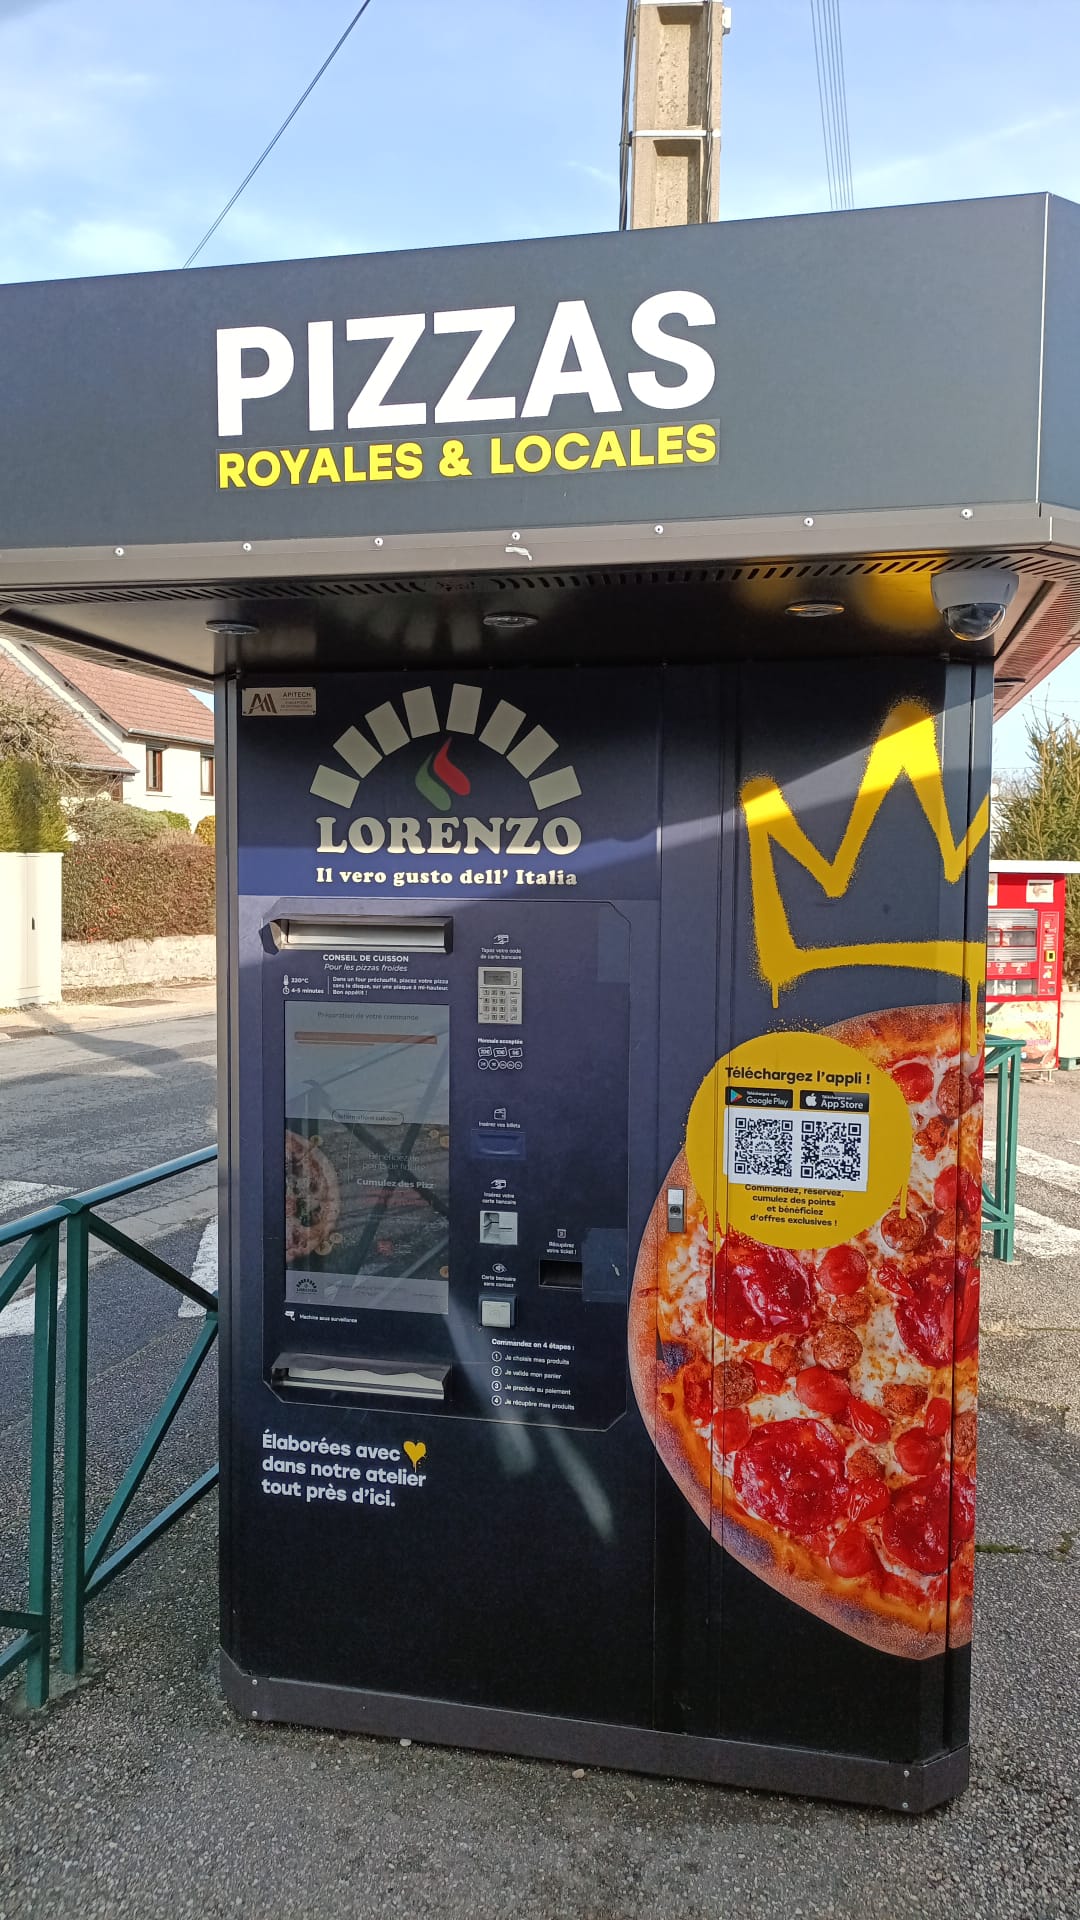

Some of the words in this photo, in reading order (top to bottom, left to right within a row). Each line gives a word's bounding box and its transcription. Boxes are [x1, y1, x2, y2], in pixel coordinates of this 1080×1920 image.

[216, 290, 716, 437] PIZZAS
[217, 442, 424, 489] ROYALES
[439, 440, 473, 477] &
[489, 423, 717, 475] LOCALES
[315, 817, 582, 855] LORENZO
[316, 867, 333, 883] Il
[339, 870, 387, 884] vero
[393, 869, 453, 887] gusto
[460, 869, 508, 884] dell'
[516, 870, 578, 886] Italia
[323, 954, 357, 962] CONSEIL
[324, 963, 341, 971] Pour
[356, 964, 379, 972] pizzas
[725, 1067, 813, 1084] Téléchargez
[817, 1070, 862, 1086] l'appli
[866, 1073, 871, 1084] !
[746, 1096, 773, 1106] Google
[773, 1097, 788, 1107] Play
[820, 1099, 839, 1109] App
[840, 1100, 863, 1109] Store
[356, 1178, 397, 1187] Cumulez
[397, 1179, 414, 1188] des
[744, 1184, 802, 1195] Commandez,
[752, 1194, 788, 1203] cumulez
[790, 1196, 806, 1204] des
[808, 1197, 836, 1206] points
[778, 1205, 824, 1216] bénéficiez
[750, 1213, 785, 1223] d'offres
[787, 1217, 832, 1226] exclusives
[491, 1338, 532, 1347] Commandez
[549, 1342, 571, 1351] étapes
[552, 1403, 575, 1411] produits
[262, 1429, 351, 1457] Élaborées
[355, 1445, 401, 1462] avec
[262, 1456, 307, 1475] dans
[310, 1462, 361, 1481] notre
[365, 1465, 427, 1487] atelier
[261, 1477, 302, 1497] tout
[306, 1483, 347, 1502] près
[351, 1487, 396, 1507] d'ici.
